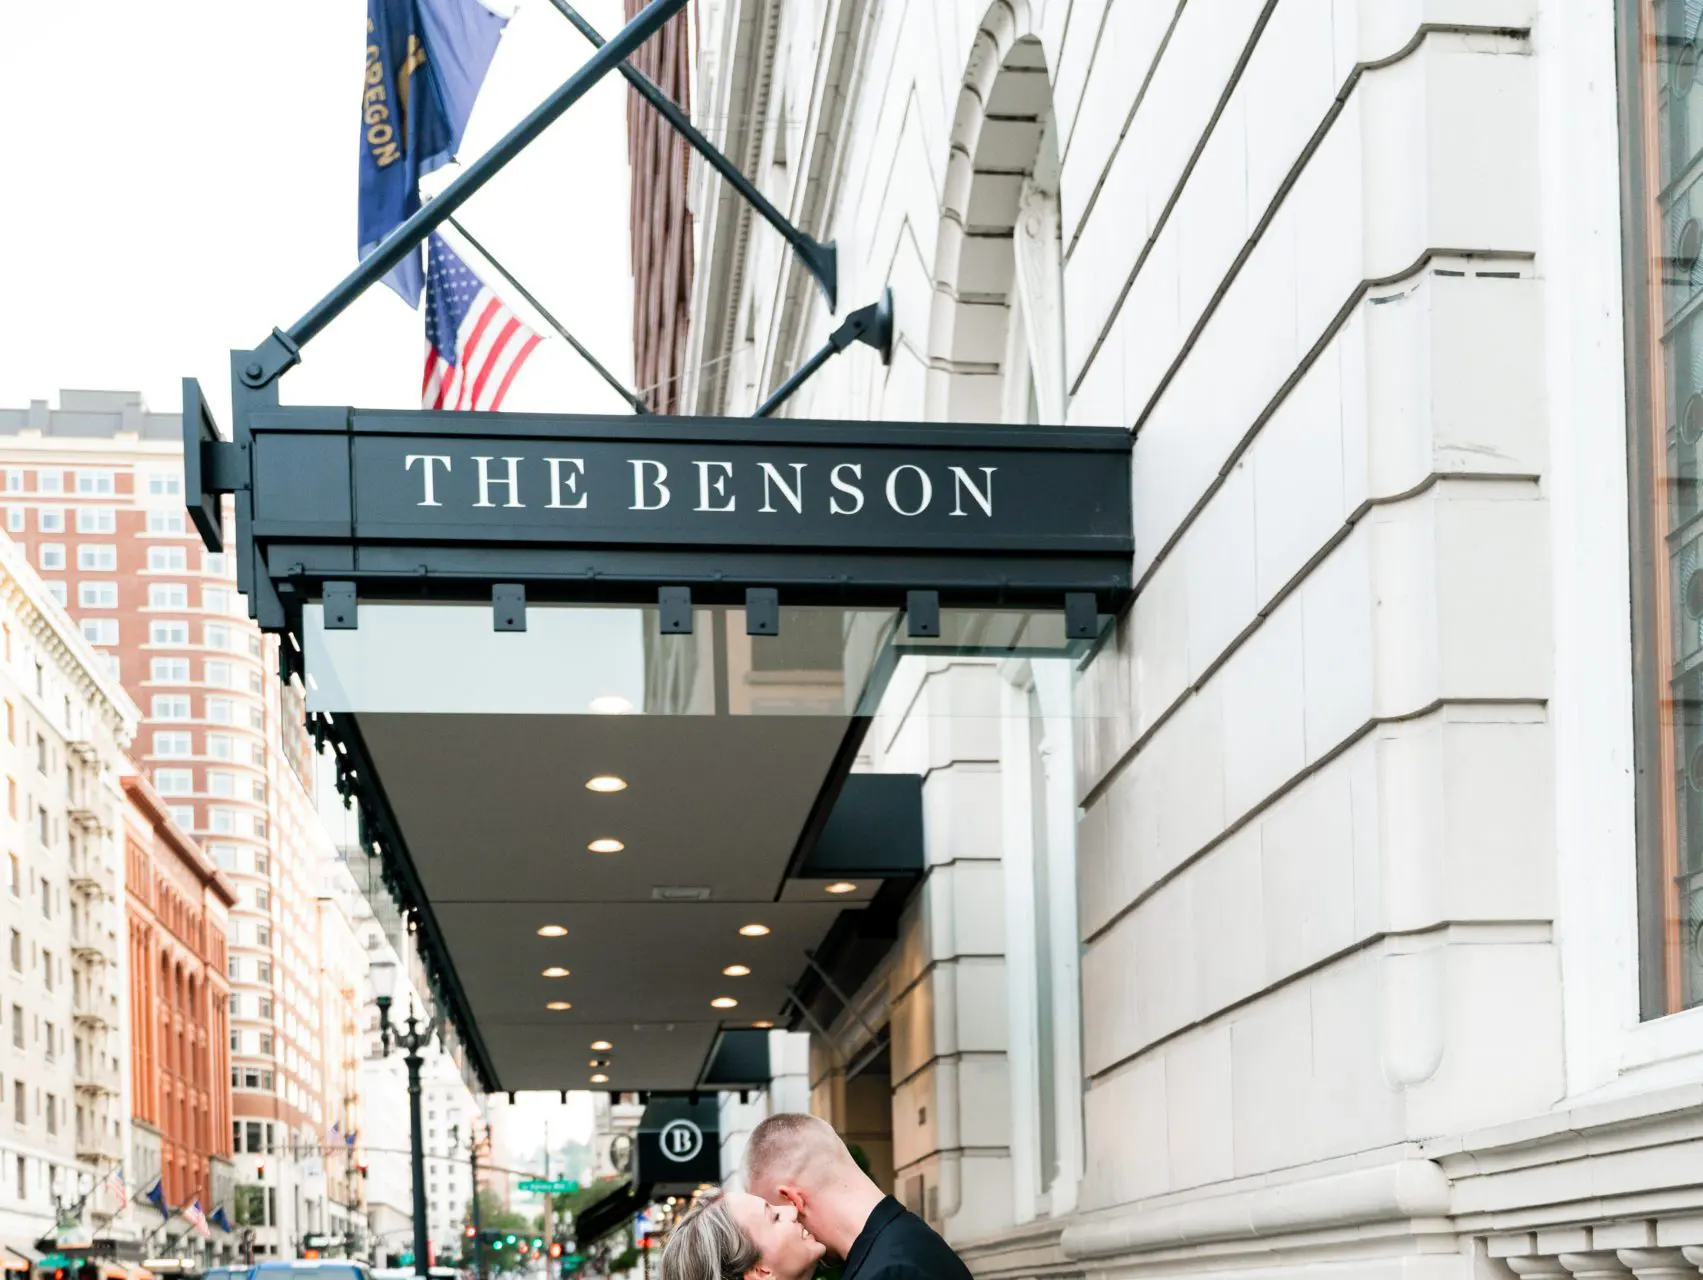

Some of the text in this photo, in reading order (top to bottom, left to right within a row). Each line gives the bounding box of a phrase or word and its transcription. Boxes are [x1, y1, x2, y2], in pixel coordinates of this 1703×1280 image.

[364, 44, 401, 168] OREGON
[405, 455, 998, 517] THE BENSON
[671, 1128, 693, 1153] B
